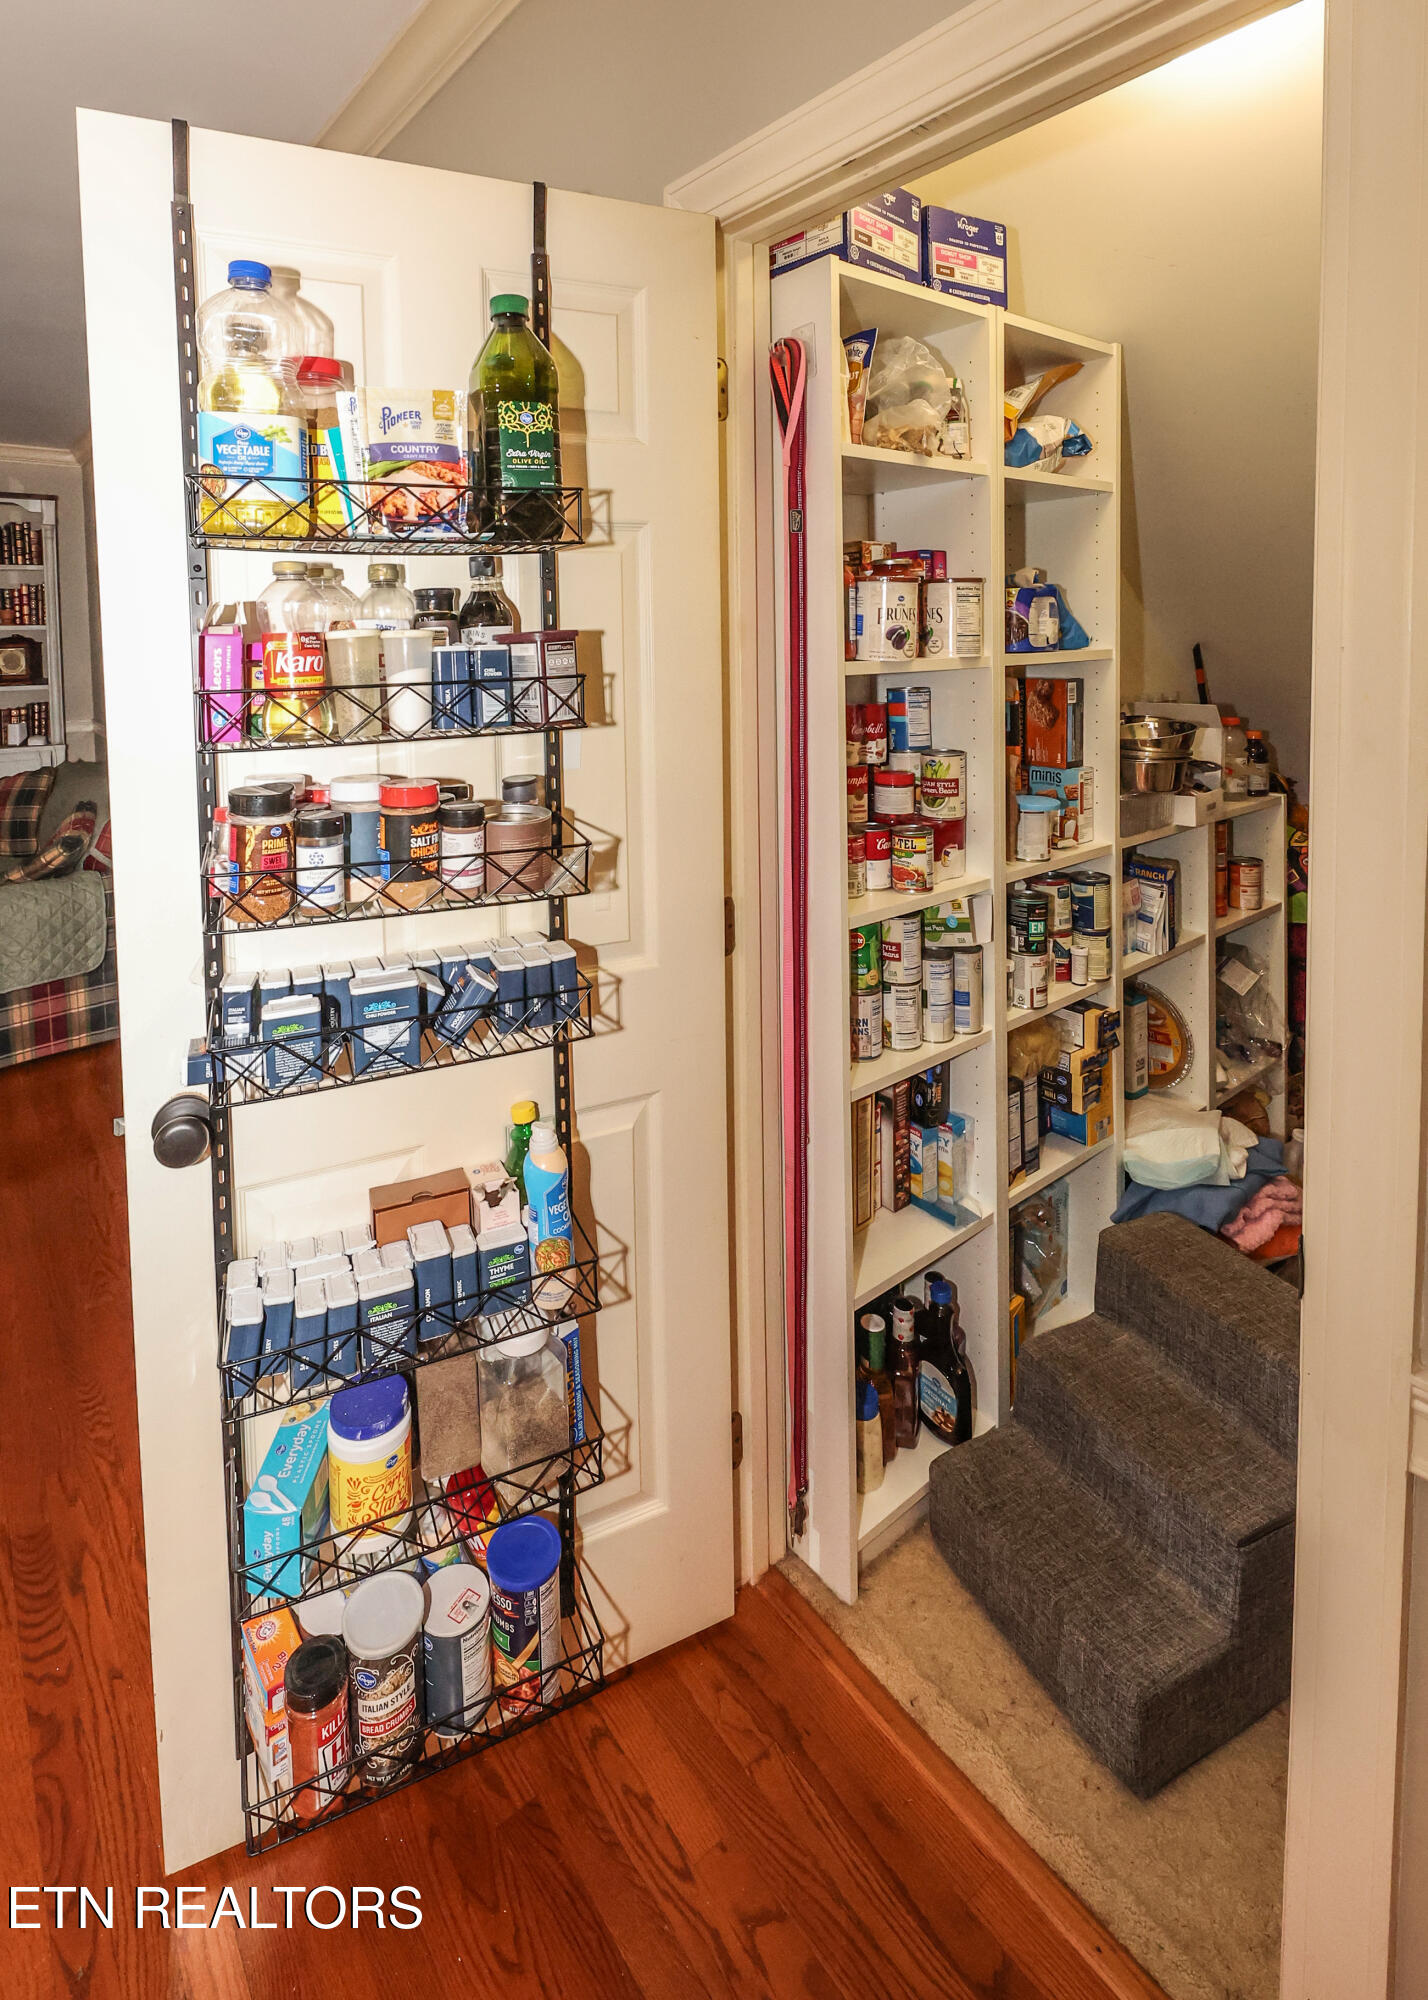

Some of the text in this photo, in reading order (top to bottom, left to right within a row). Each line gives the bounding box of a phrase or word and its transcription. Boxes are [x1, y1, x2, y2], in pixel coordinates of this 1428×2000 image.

[957, 217, 979, 237] Kroger
[216, 444, 271, 457] VEGETABLE
[390, 444, 440, 455] COUNTRY
[505, 448, 552, 460] Extra Virgin
[926, 607, 943, 624] NES
[275, 651, 324, 674] Karo
[1031, 768, 1062, 785] minis
[262, 837, 288, 850] PRIME
[410, 836, 432, 848] SALT
[410, 843, 439, 858] CHICKE
[1134, 867, 1166, 881] RANCH
[1031, 921, 1044, 934] EN
[489, 1262, 515, 1276] THYME
[369, 1312, 393, 1323] ITALIAN
[278, 1423, 312, 1479] Everyday
[357, 1673, 376, 1688] Kroger
[361, 1682, 411, 1713] ITALIAN STYLE
[321, 1711, 346, 1741] KILLE
[361, 1702, 413, 1735] BREAD CRUMBS
